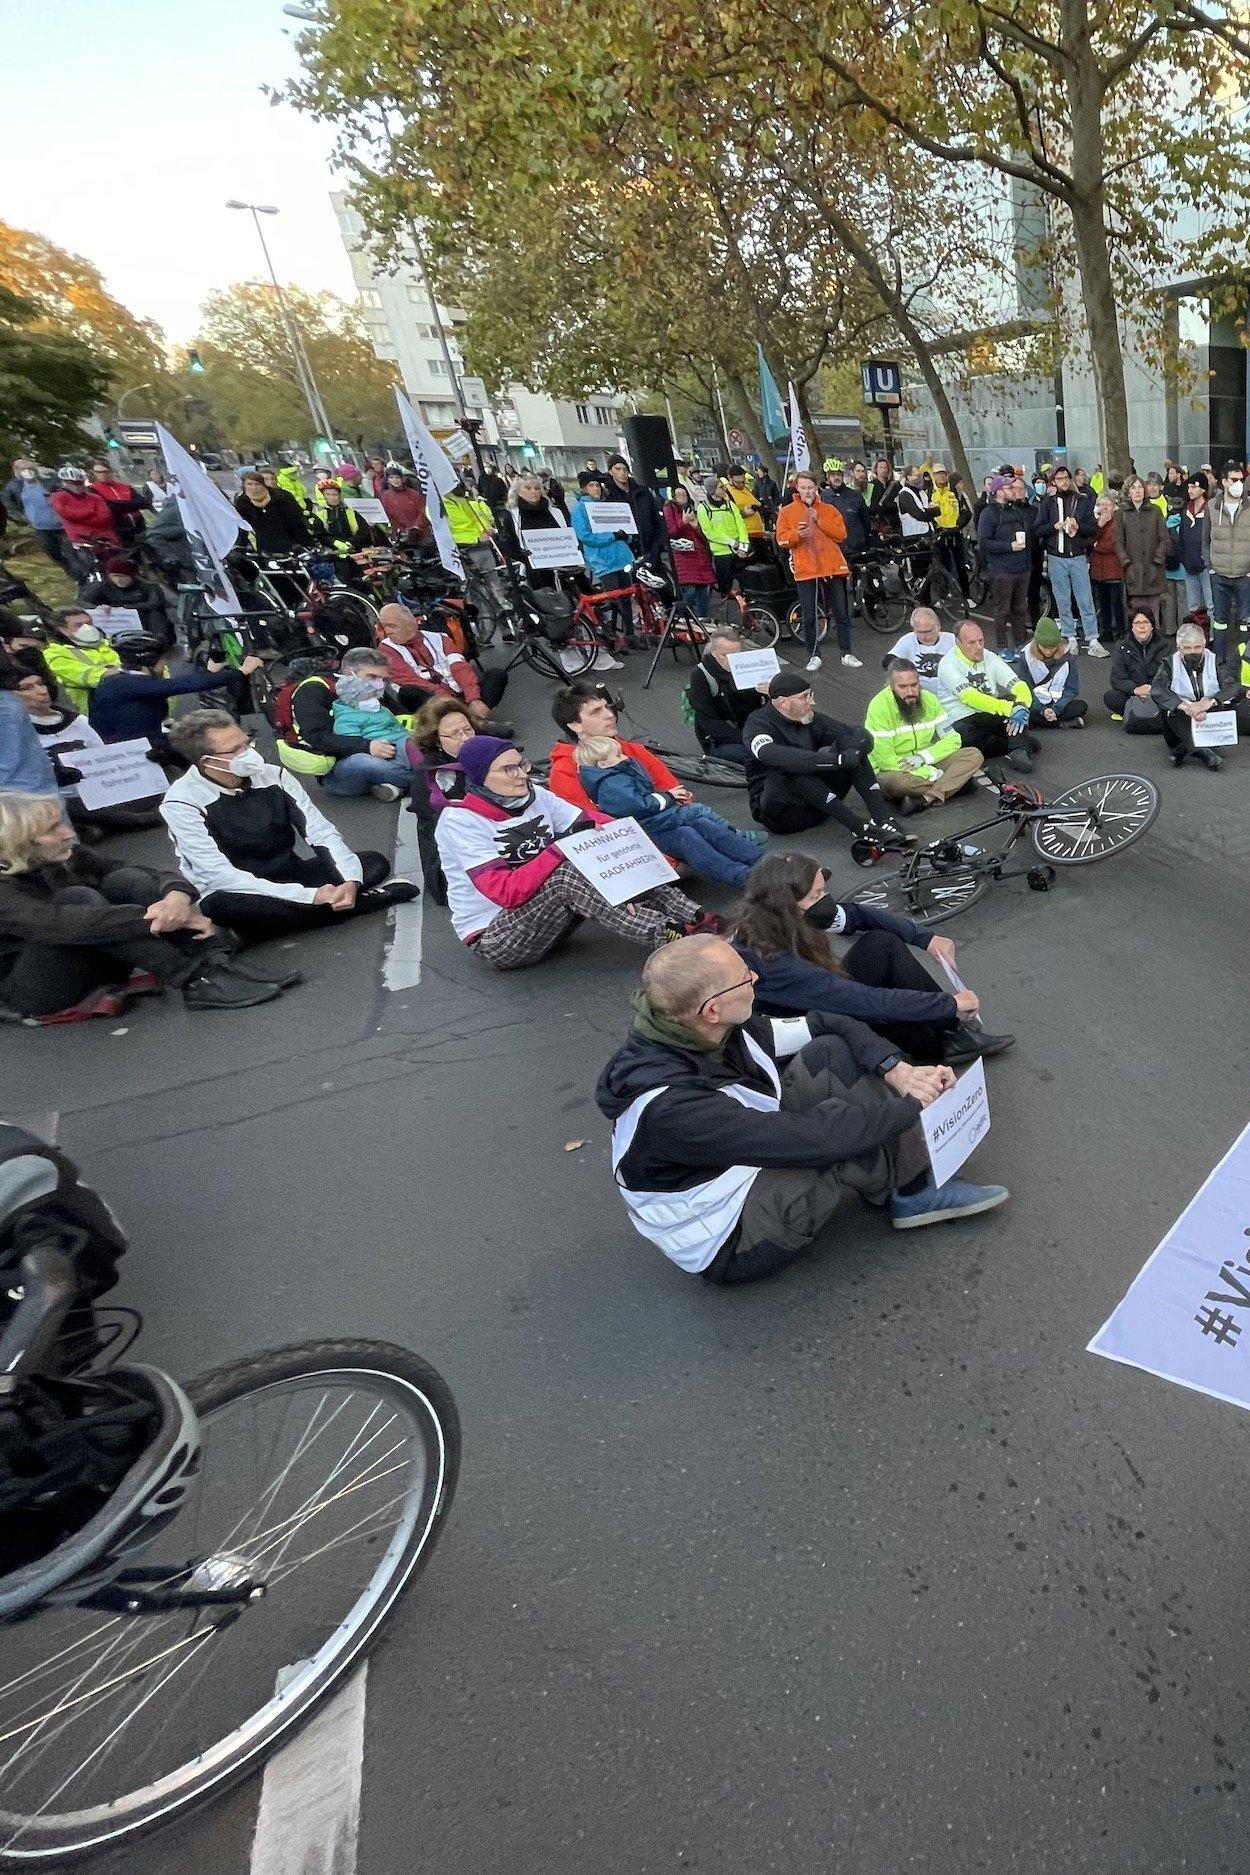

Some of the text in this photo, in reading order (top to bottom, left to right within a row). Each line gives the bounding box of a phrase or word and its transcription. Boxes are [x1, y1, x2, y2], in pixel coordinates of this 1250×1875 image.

[877, 368, 893, 390] U
[572, 826, 638, 854] MAHNWACHE
[932, 1086, 983, 1143] #VisionZero
